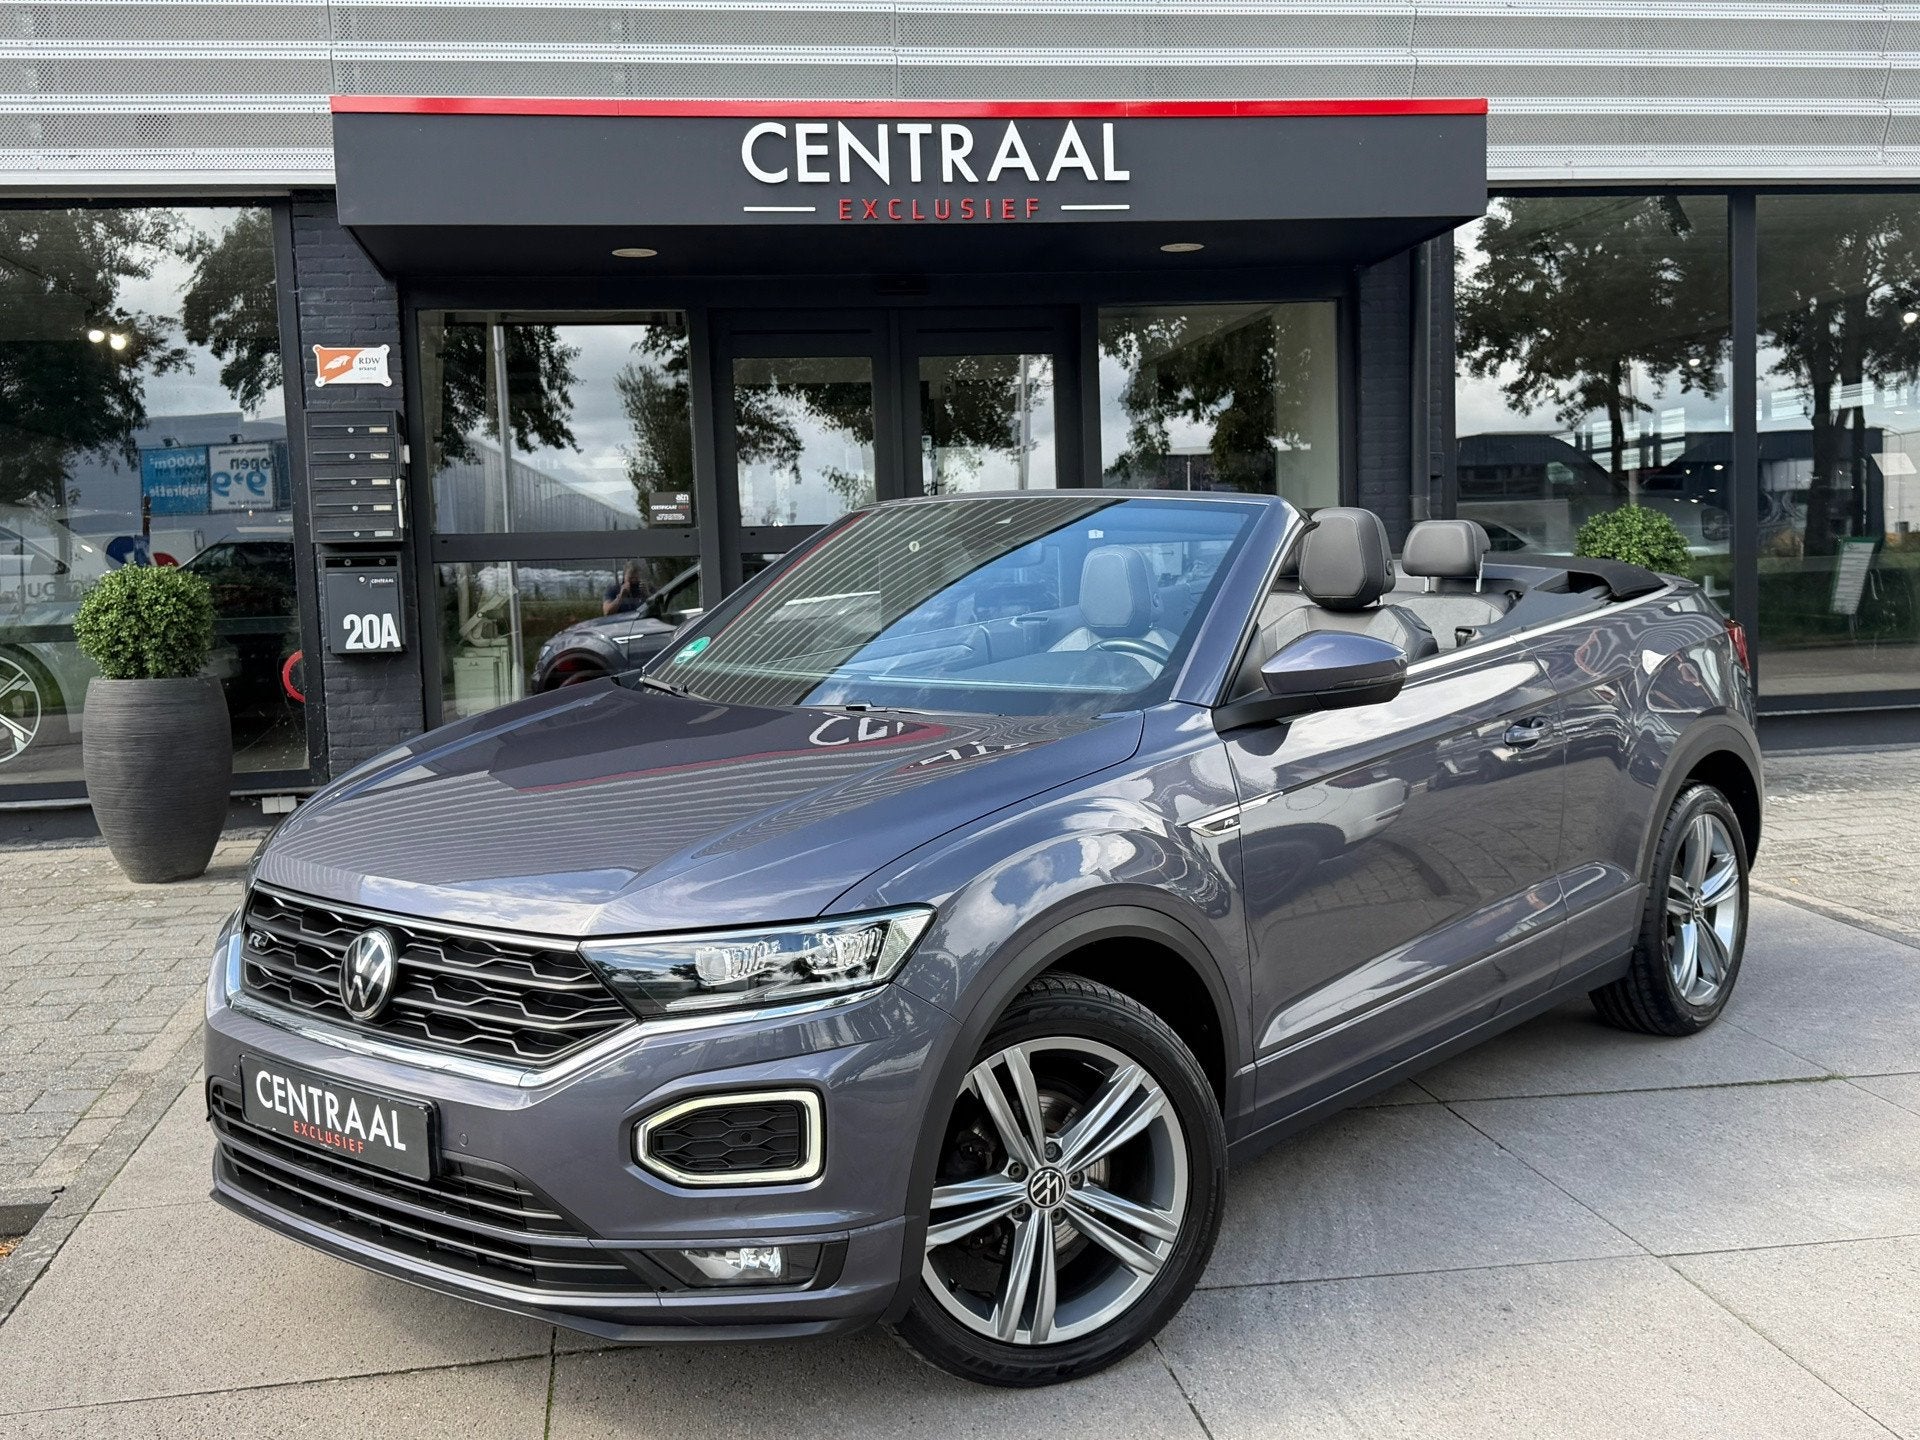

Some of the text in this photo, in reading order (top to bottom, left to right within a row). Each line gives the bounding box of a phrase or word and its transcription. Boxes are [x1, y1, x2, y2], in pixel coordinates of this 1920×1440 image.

[741, 120, 1130, 185] CENTRAAL
[839, 198, 1040, 220] EXCLUSIEF
[358, 357, 381, 365] RDW
[343, 613, 402, 650] 20A
[255, 1070, 407, 1151] CENTRAAL
[293, 1120, 364, 1154] EXCLUSIEF
